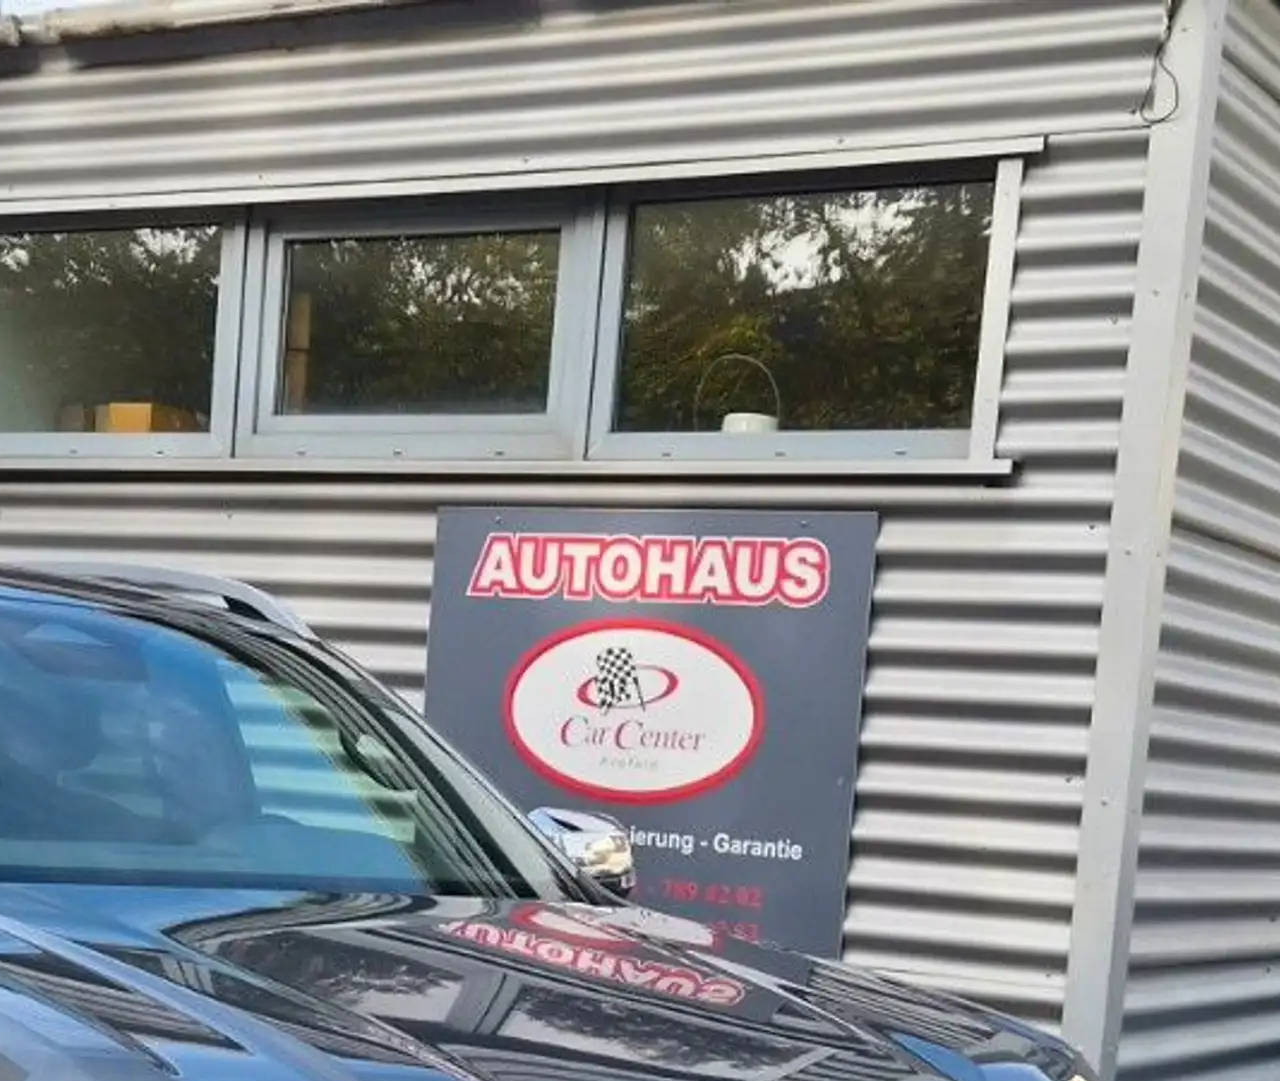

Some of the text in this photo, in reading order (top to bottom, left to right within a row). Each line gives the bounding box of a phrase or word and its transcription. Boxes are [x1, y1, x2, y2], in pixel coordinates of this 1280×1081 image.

[466, 533, 831, 608] AUTOHAUS
[560, 714, 706, 751] Car Center
[629, 826, 694, 855] ierung
[713, 833, 803, 861] Garantie
